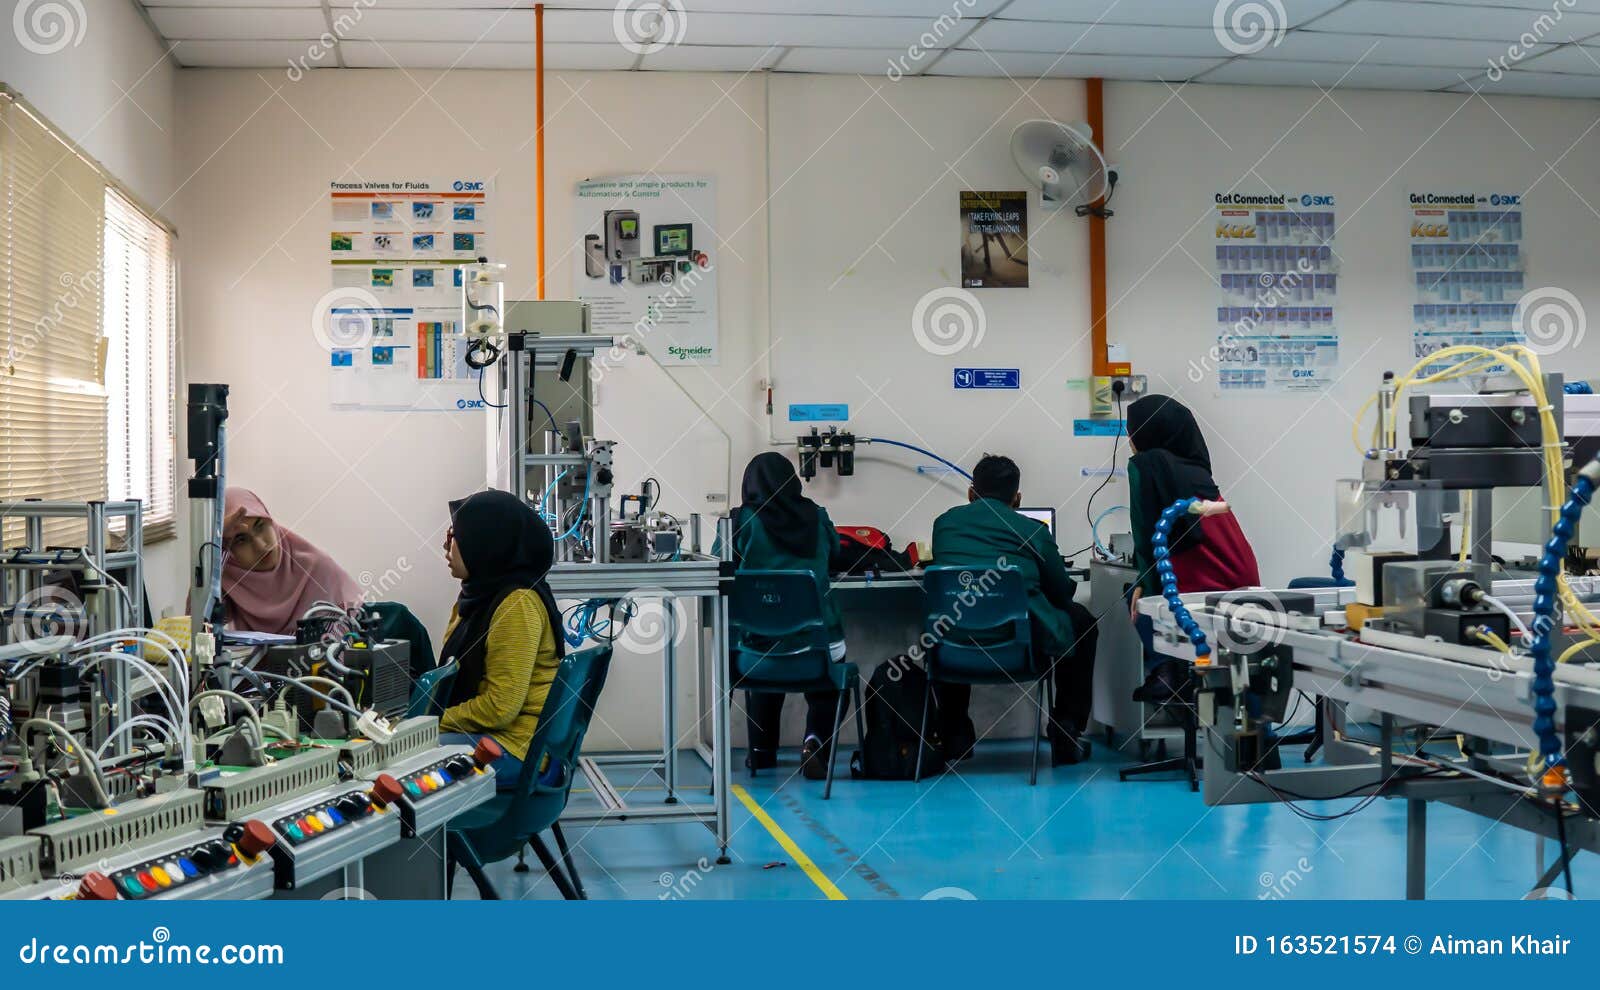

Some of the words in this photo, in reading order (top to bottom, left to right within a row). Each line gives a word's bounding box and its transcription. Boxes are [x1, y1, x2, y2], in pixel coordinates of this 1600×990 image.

[331, 182, 363, 190] Process
[365, 182, 390, 190] Valves
[391, 182, 403, 190] for
[405, 182, 430, 190] Fluids
[661, 180, 695, 190] products
[696, 180, 707, 188] for
[578, 190, 622, 198] Automation
[632, 190, 660, 198] Control
[1215, 193, 1232, 204] Get
[1234, 193, 1285, 204] Connected
[1409, 194, 1426, 204] Get
[1427, 193, 1475, 204] Connected
[970, 212, 985, 221] TAKE
[1003, 212, 1020, 222] LEAPS
[981, 224, 993, 233] THE
[668, 346, 713, 355] Schneider
